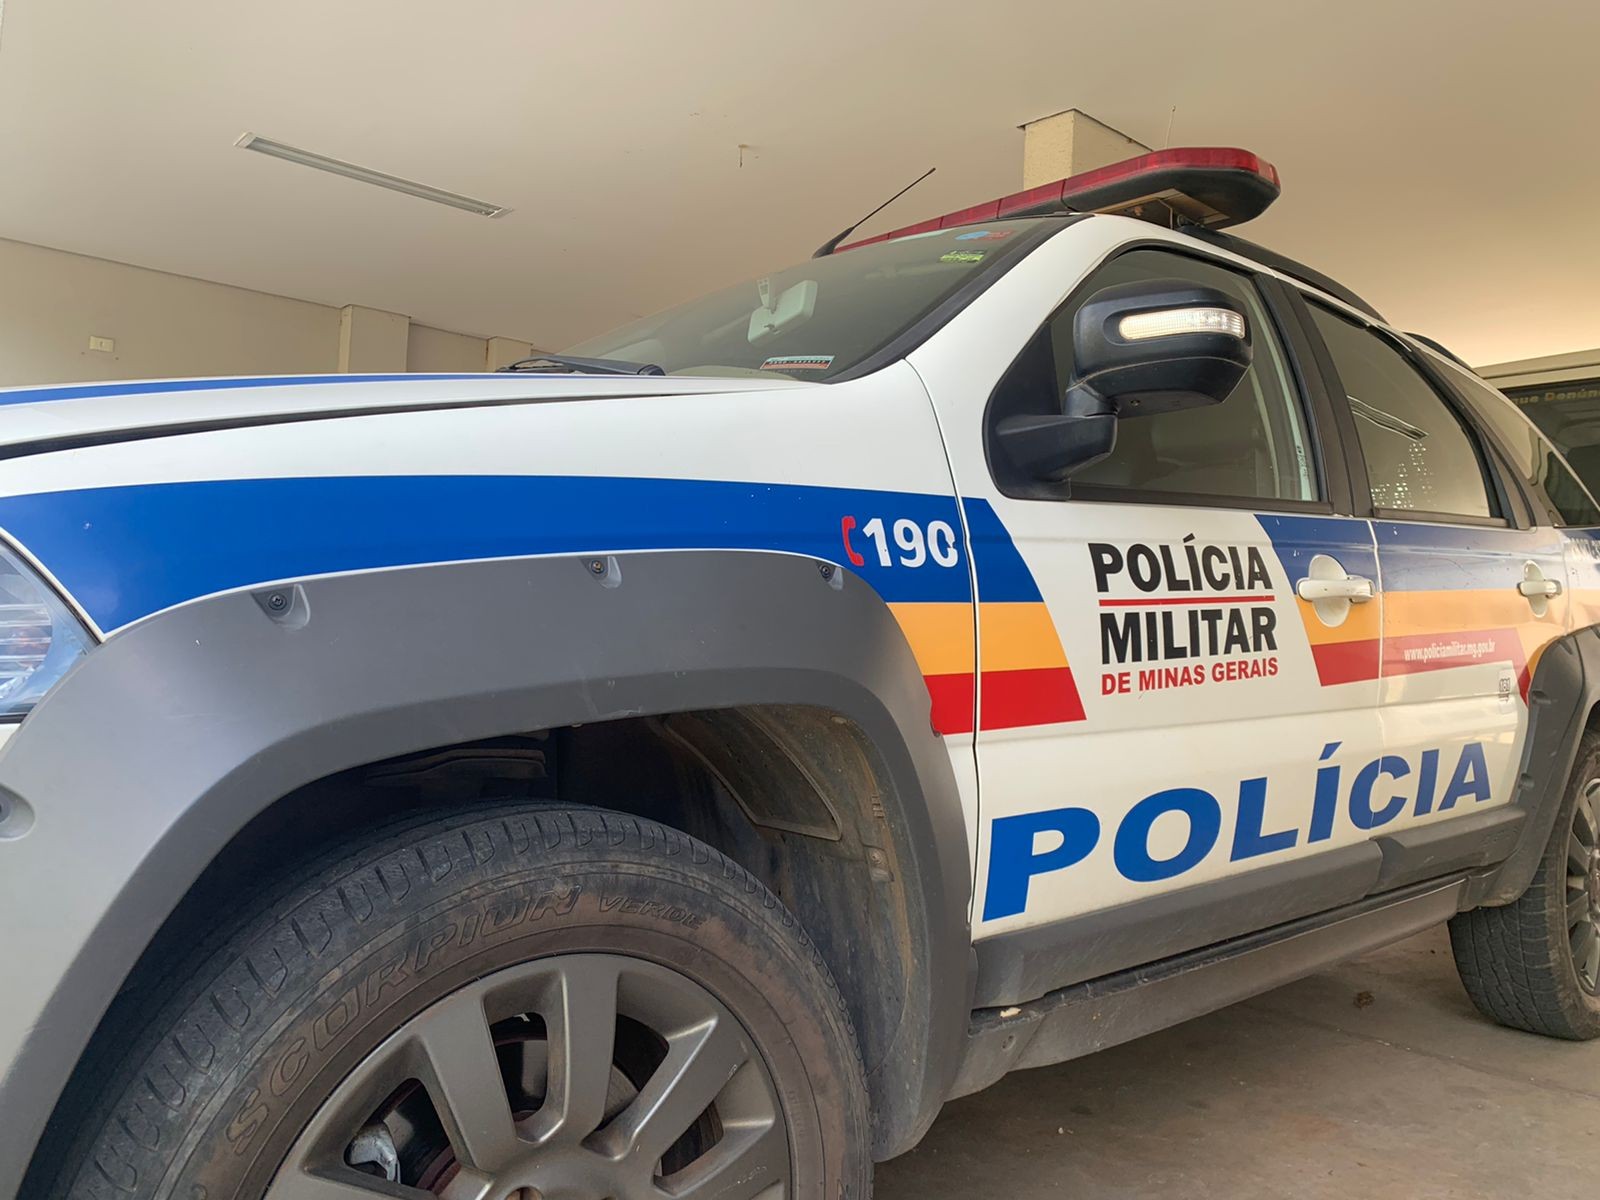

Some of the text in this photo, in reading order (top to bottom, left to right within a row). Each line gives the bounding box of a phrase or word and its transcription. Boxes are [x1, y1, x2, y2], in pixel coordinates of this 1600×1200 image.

[1544, 388, 1600, 402] Donún
[862, 518, 958, 567] 190
[1088, 533, 1273, 592] POLÍCIA
[1100, 607, 1277, 664] MILITAR
[1102, 657, 1278, 695] DE MINAS GERAIS
[982, 742, 1491, 922] POLÍCIA
[226, 885, 583, 1155] SCORPION
